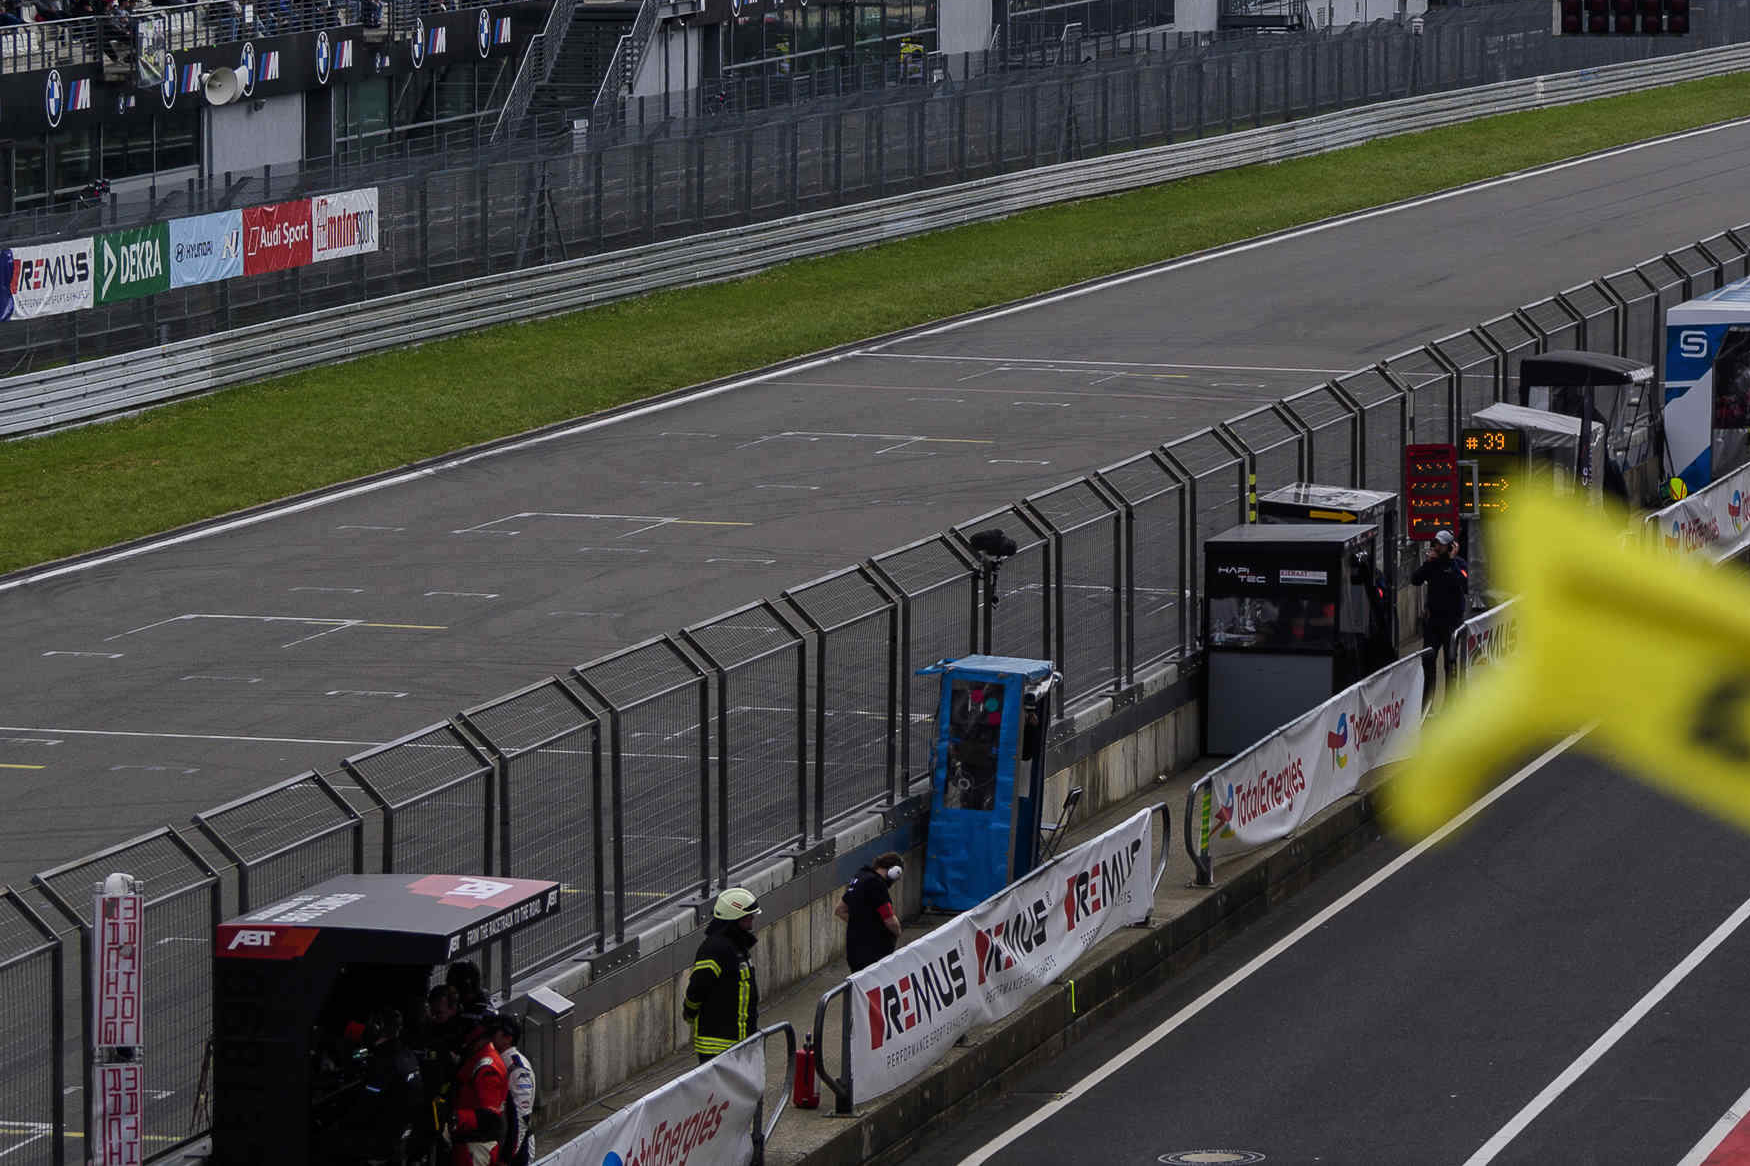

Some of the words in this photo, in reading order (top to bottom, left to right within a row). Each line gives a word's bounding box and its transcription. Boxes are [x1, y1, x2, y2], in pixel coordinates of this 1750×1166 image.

[259, 221, 281, 249] Audi
[282, 220, 309, 249] Sport
[327, 207, 375, 249] motorsport
[120, 238, 162, 285] DEKRA
[185, 241, 213, 259] HYUNDAI
[18, 251, 89, 292] REMUS
[1483, 433, 1505, 450] 39
[1236, 752, 1305, 828] TotalEnergies
[227, 929, 276, 950] ABT
[103, 897, 120, 1046] RACING
[883, 947, 968, 1041] REMUS
[887, 1033, 930, 1068] PERFORMANCE
